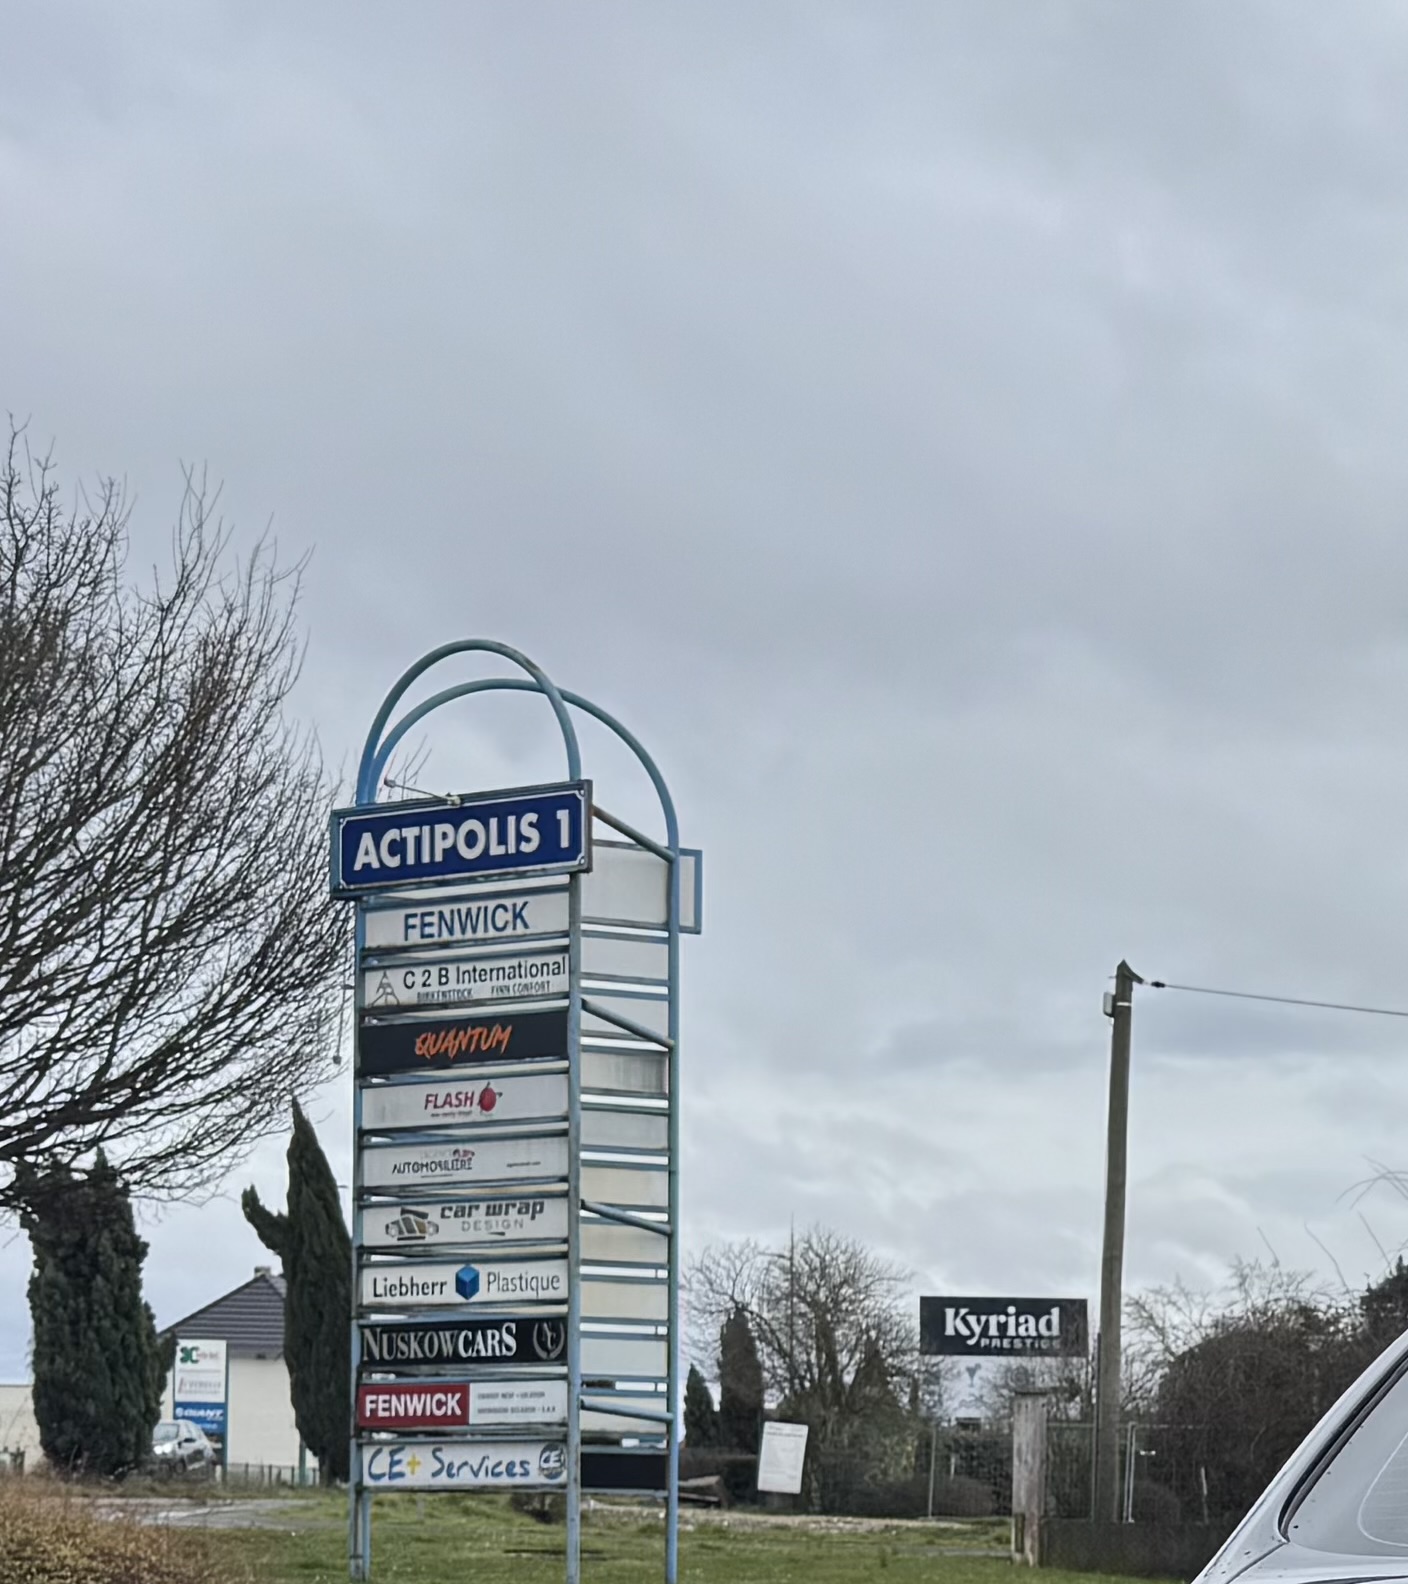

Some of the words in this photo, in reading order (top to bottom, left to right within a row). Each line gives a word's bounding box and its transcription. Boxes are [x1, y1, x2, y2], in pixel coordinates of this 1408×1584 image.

[353, 812, 541, 871] ACTIPOLIS
[556, 808, 571, 849] 1
[403, 901, 530, 942] FENWICK
[403, 970, 416, 990] C
[421, 969, 432, 988] 2
[438, 966, 449, 986] B
[456, 956, 566, 985] International
[414, 1024, 512, 1059] QUANTUM
[424, 1091, 475, 1110] FLASH
[440, 1204, 480, 1219] car
[485, 1200, 545, 1220] wrap
[461, 1220, 524, 1232] DESIGN
[373, 1276, 447, 1298] Liebherr
[487, 1271, 561, 1298] Plastique
[944, 1306, 1061, 1345] Kyriad
[365, 1393, 462, 1418] FENWICK
[431, 1447, 530, 1478] Services
